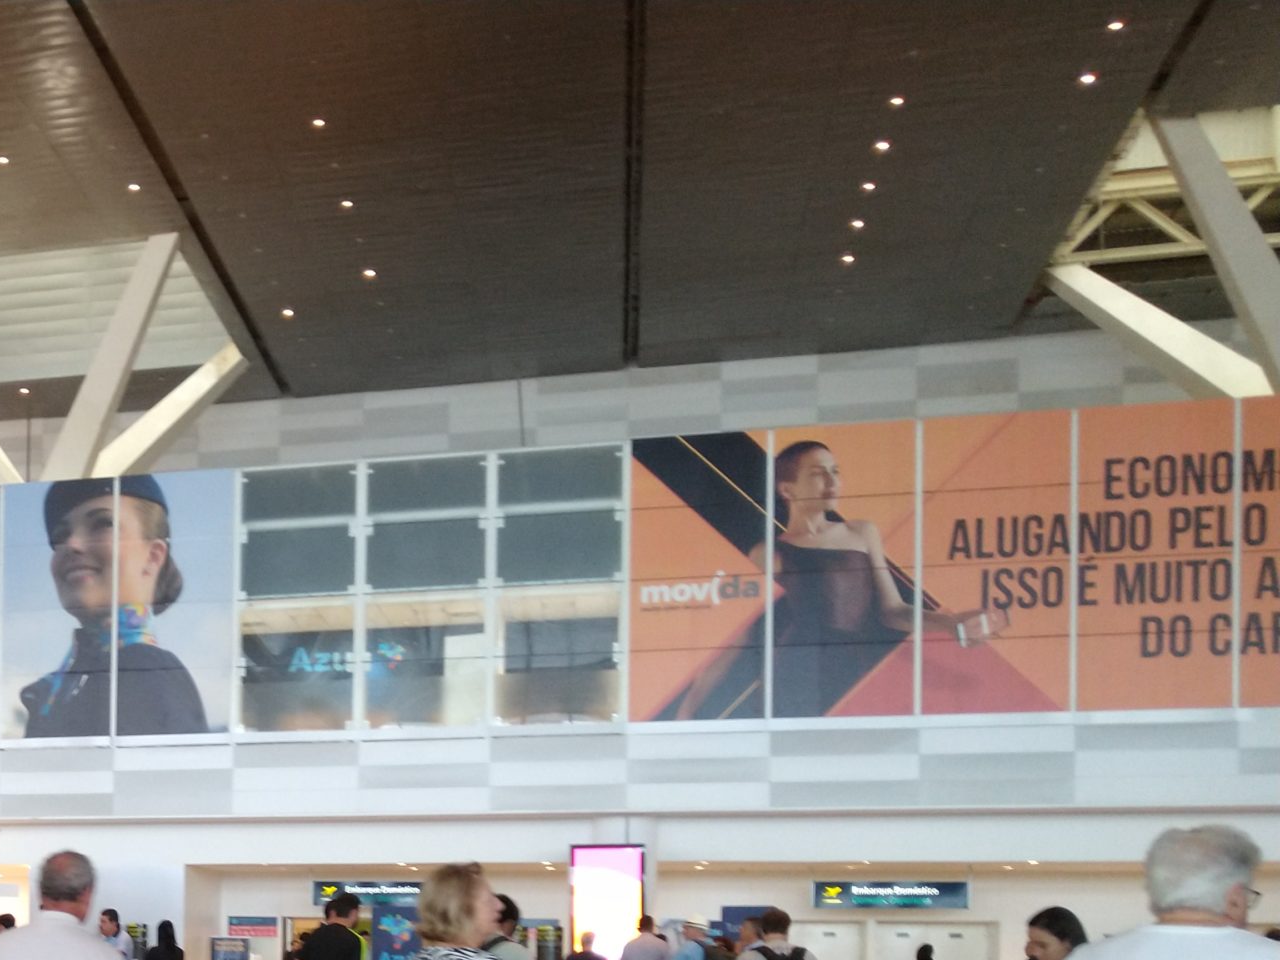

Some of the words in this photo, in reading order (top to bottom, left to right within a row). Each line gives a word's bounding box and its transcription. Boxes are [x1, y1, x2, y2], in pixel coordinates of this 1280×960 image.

[947, 508, 1153, 560] ALUGANDO
[1169, 503, 1267, 550] PELO
[640, 570, 760, 605] movida
[981, 566, 1064, 610] ISSO
[1078, 555, 1099, 606] É
[1114, 557, 1233, 605] MUITO
[1140, 615, 1193, 659] DO
